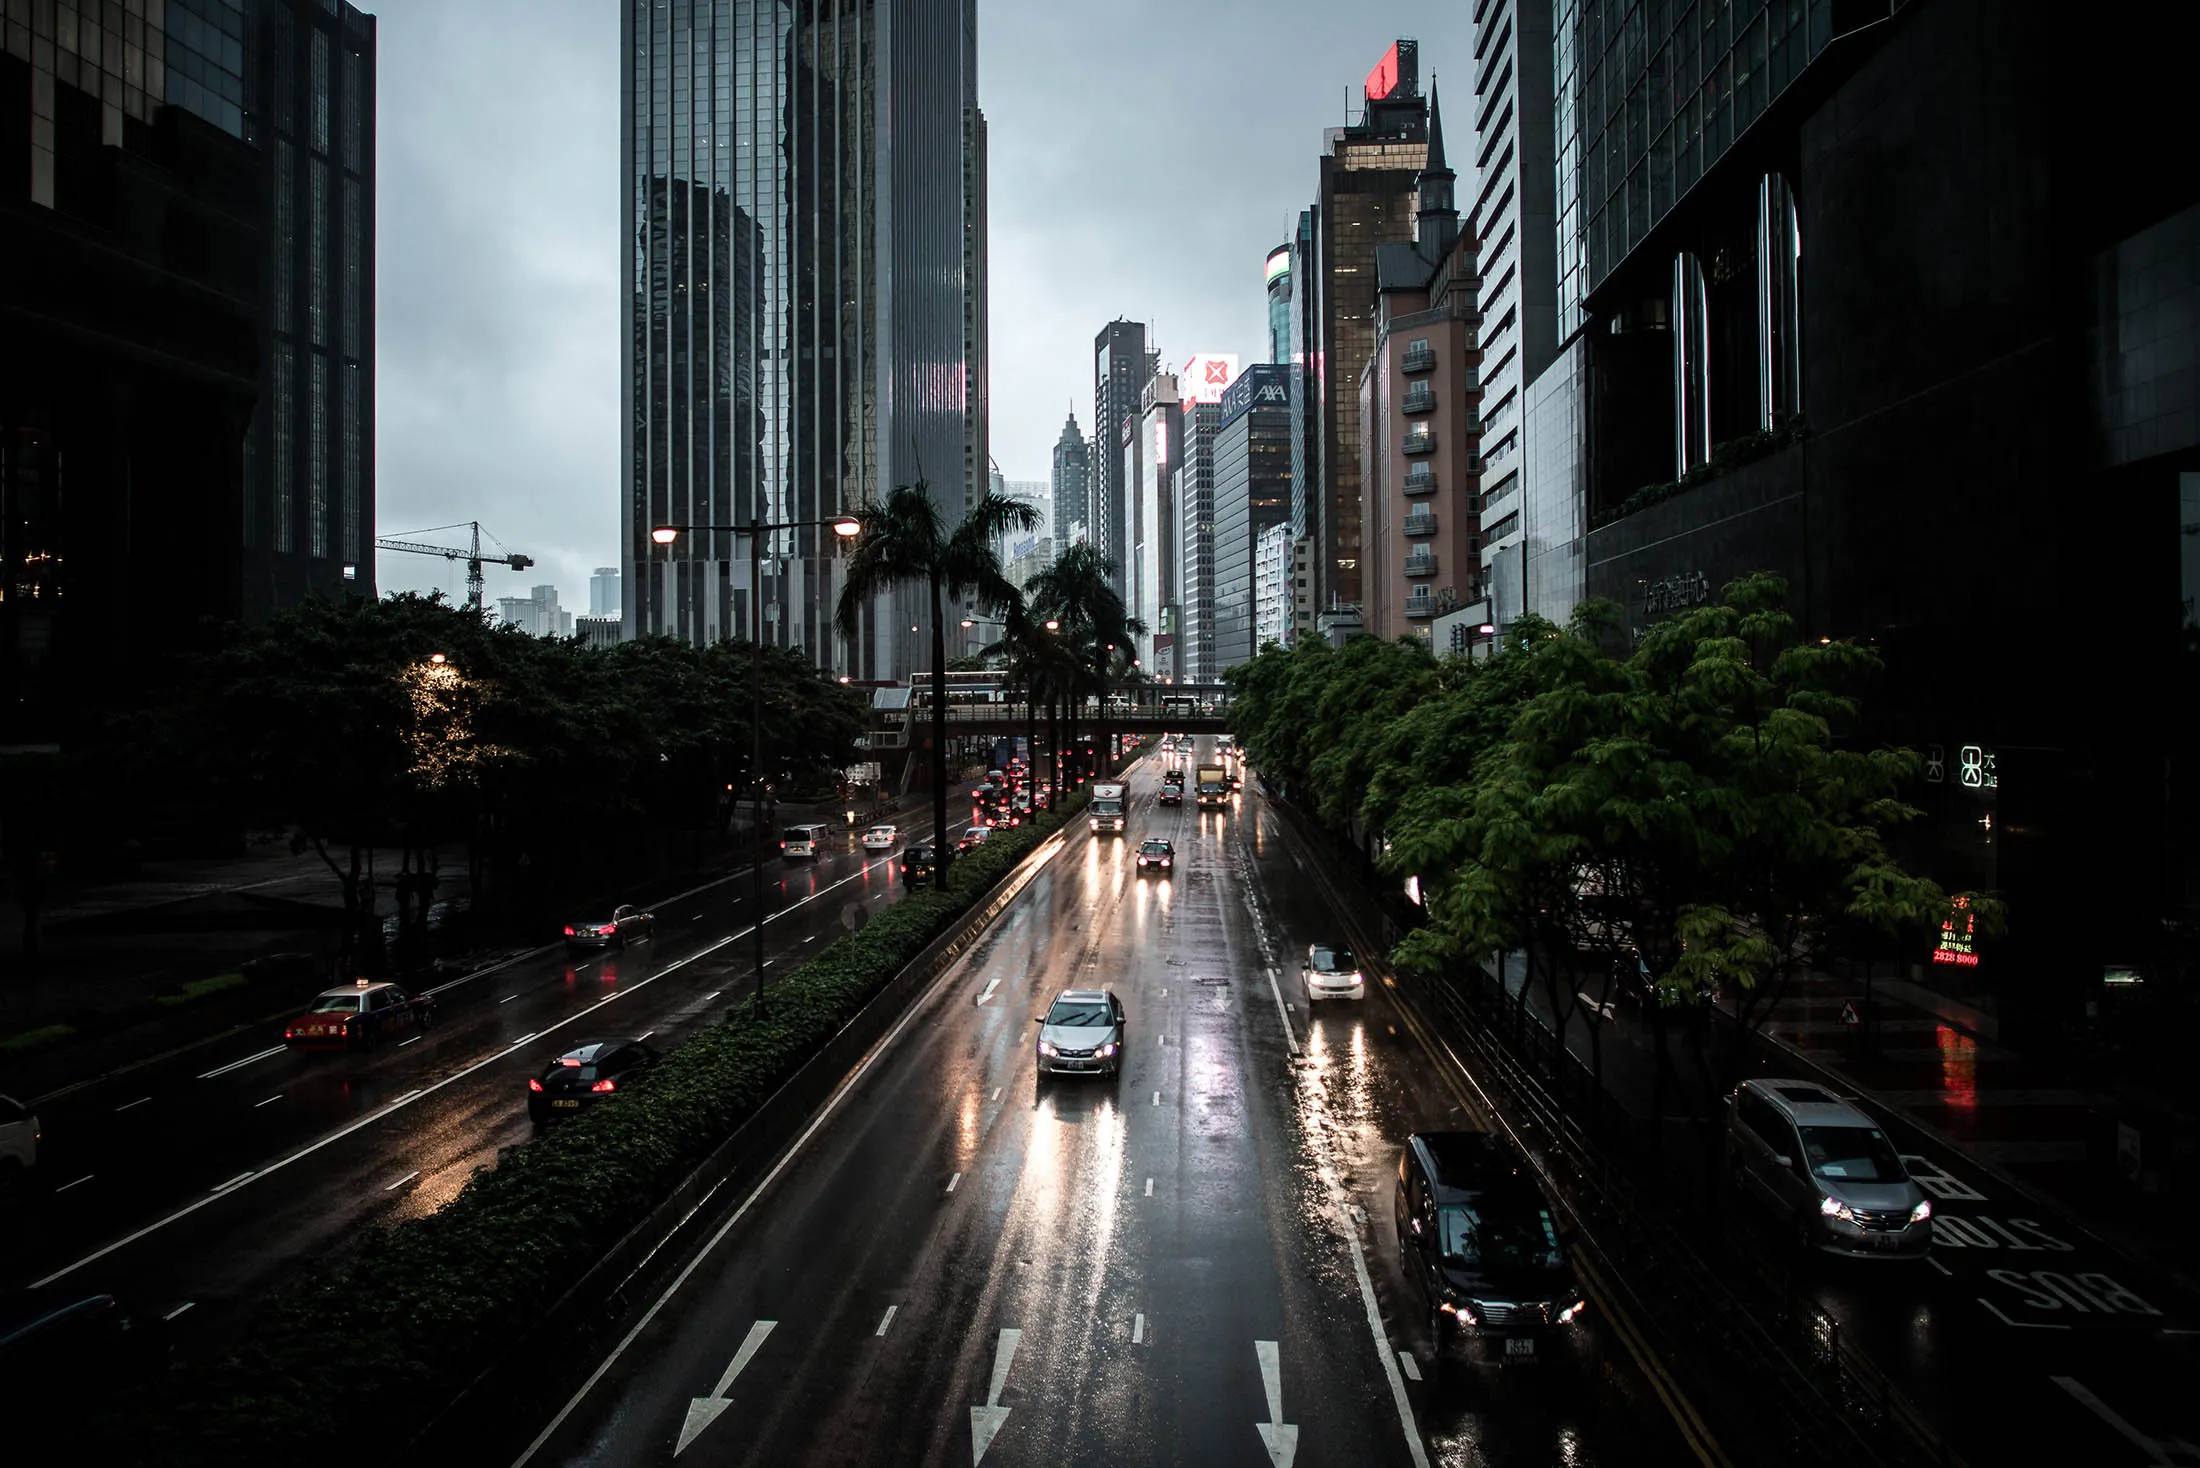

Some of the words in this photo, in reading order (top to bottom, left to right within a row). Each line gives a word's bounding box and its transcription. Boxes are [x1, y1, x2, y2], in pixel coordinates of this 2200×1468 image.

[1254, 384, 1287, 401] AXA
[1934, 951, 1956, 962] 2828
[1956, 953, 1978, 966] 8000
[1985, 1268, 2165, 1316] BUS
